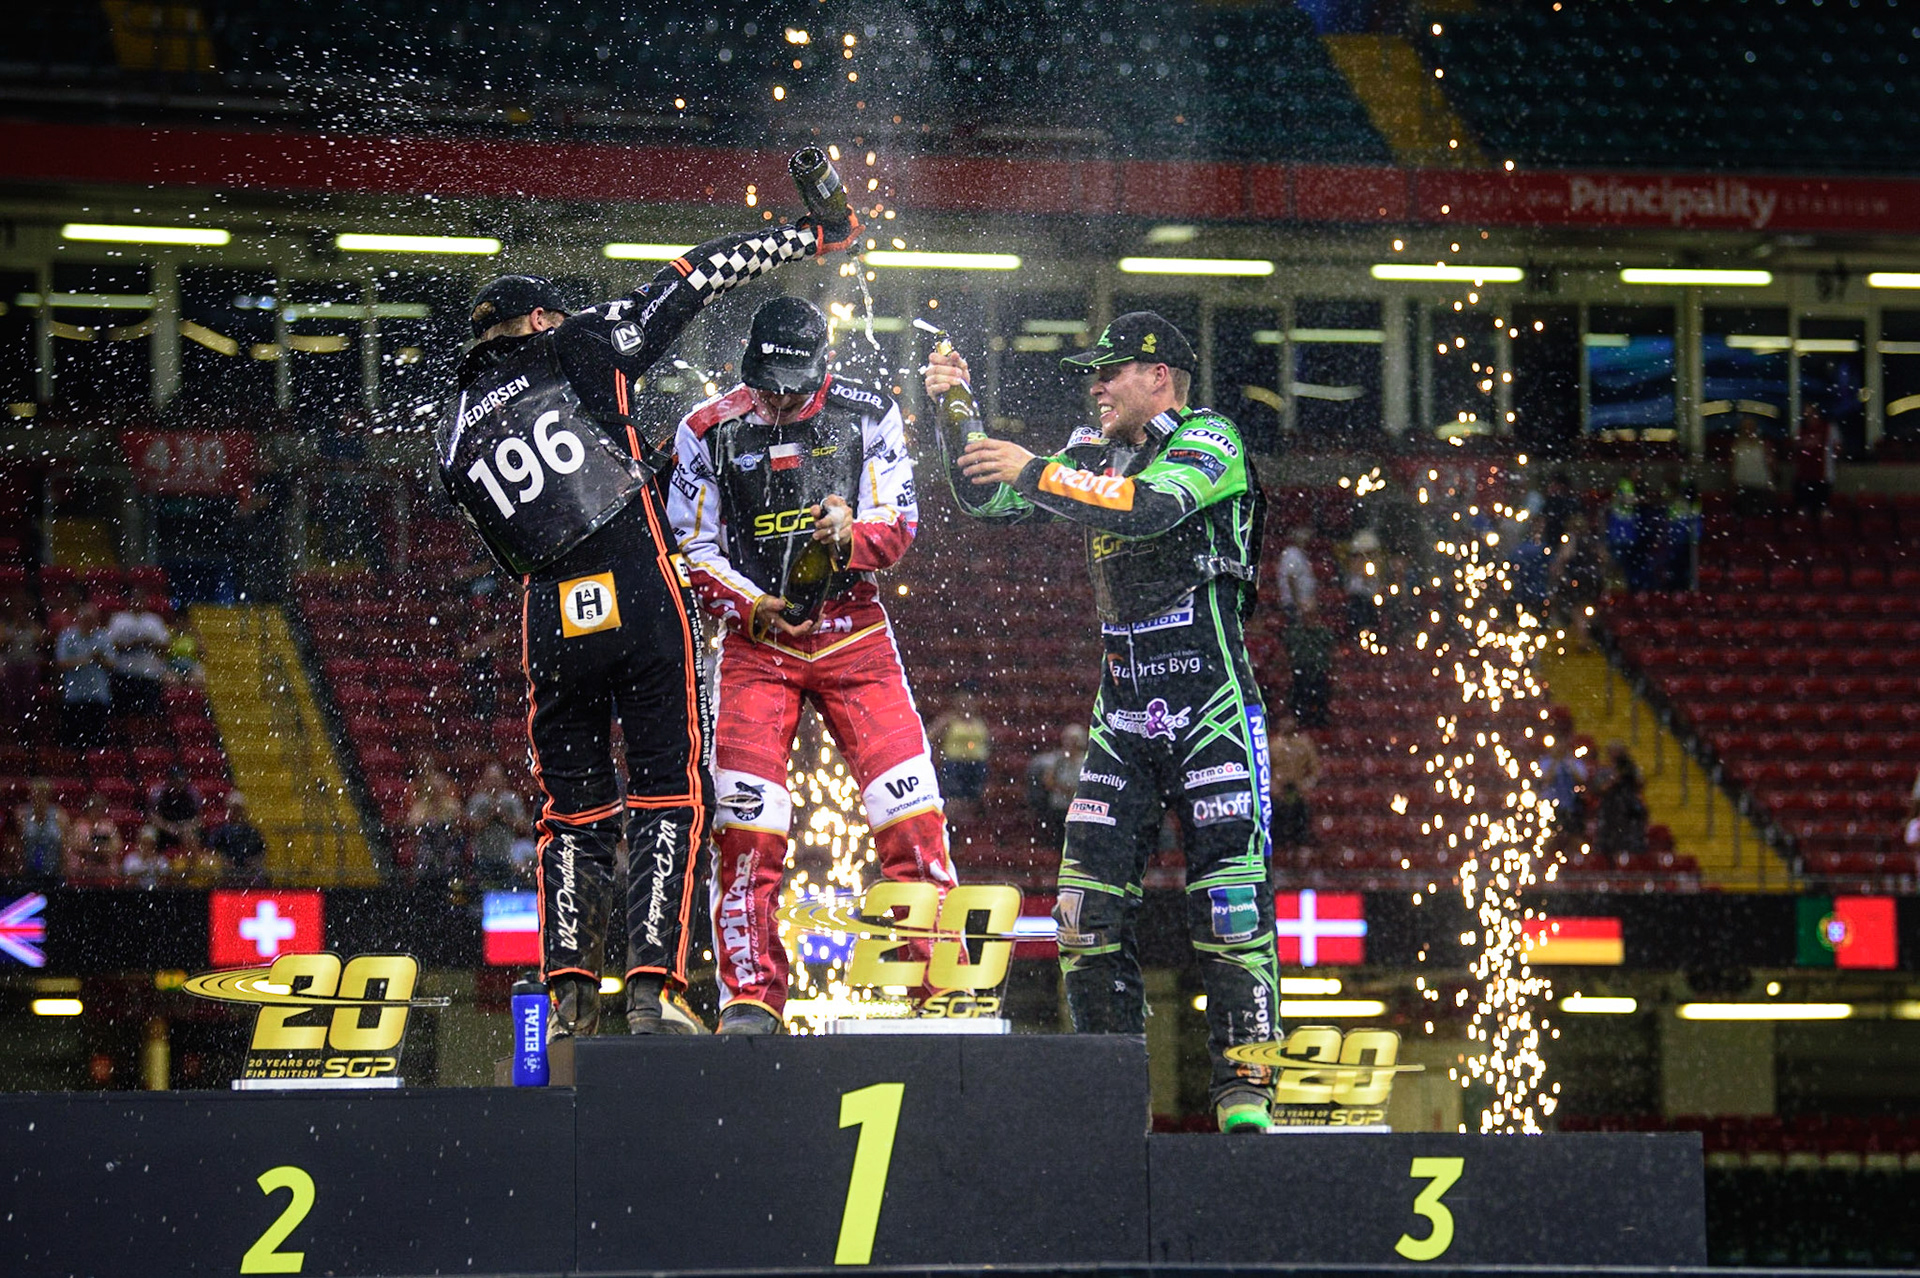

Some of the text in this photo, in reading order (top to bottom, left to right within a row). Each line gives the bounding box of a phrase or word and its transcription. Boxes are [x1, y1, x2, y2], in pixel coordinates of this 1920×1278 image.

[1570, 178, 1777, 229] Principality
[459, 375, 530, 434] PEDERSEN
[467, 410, 585, 519] 196
[1169, 657, 1201, 674] Byg
[737, 811, 756, 821] PZM
[1194, 792, 1252, 820] Orloff
[847, 881, 1021, 990] 20
[250, 953, 418, 1051] 20
[921, 996, 1000, 1019] SGP
[524, 1004, 540, 1053] ELTAL
[245, 1069, 318, 1078] FIM BRITISH
[248, 1058, 322, 1068] 20 YEARS OF
[322, 1057, 397, 1078] SGP
[1275, 1029, 1400, 1105] 20
[1329, 1109, 1384, 1126] SGP
[835, 1083, 904, 1265] 1
[240, 1166, 315, 1274] 2
[1395, 1157, 1463, 1261] 3
